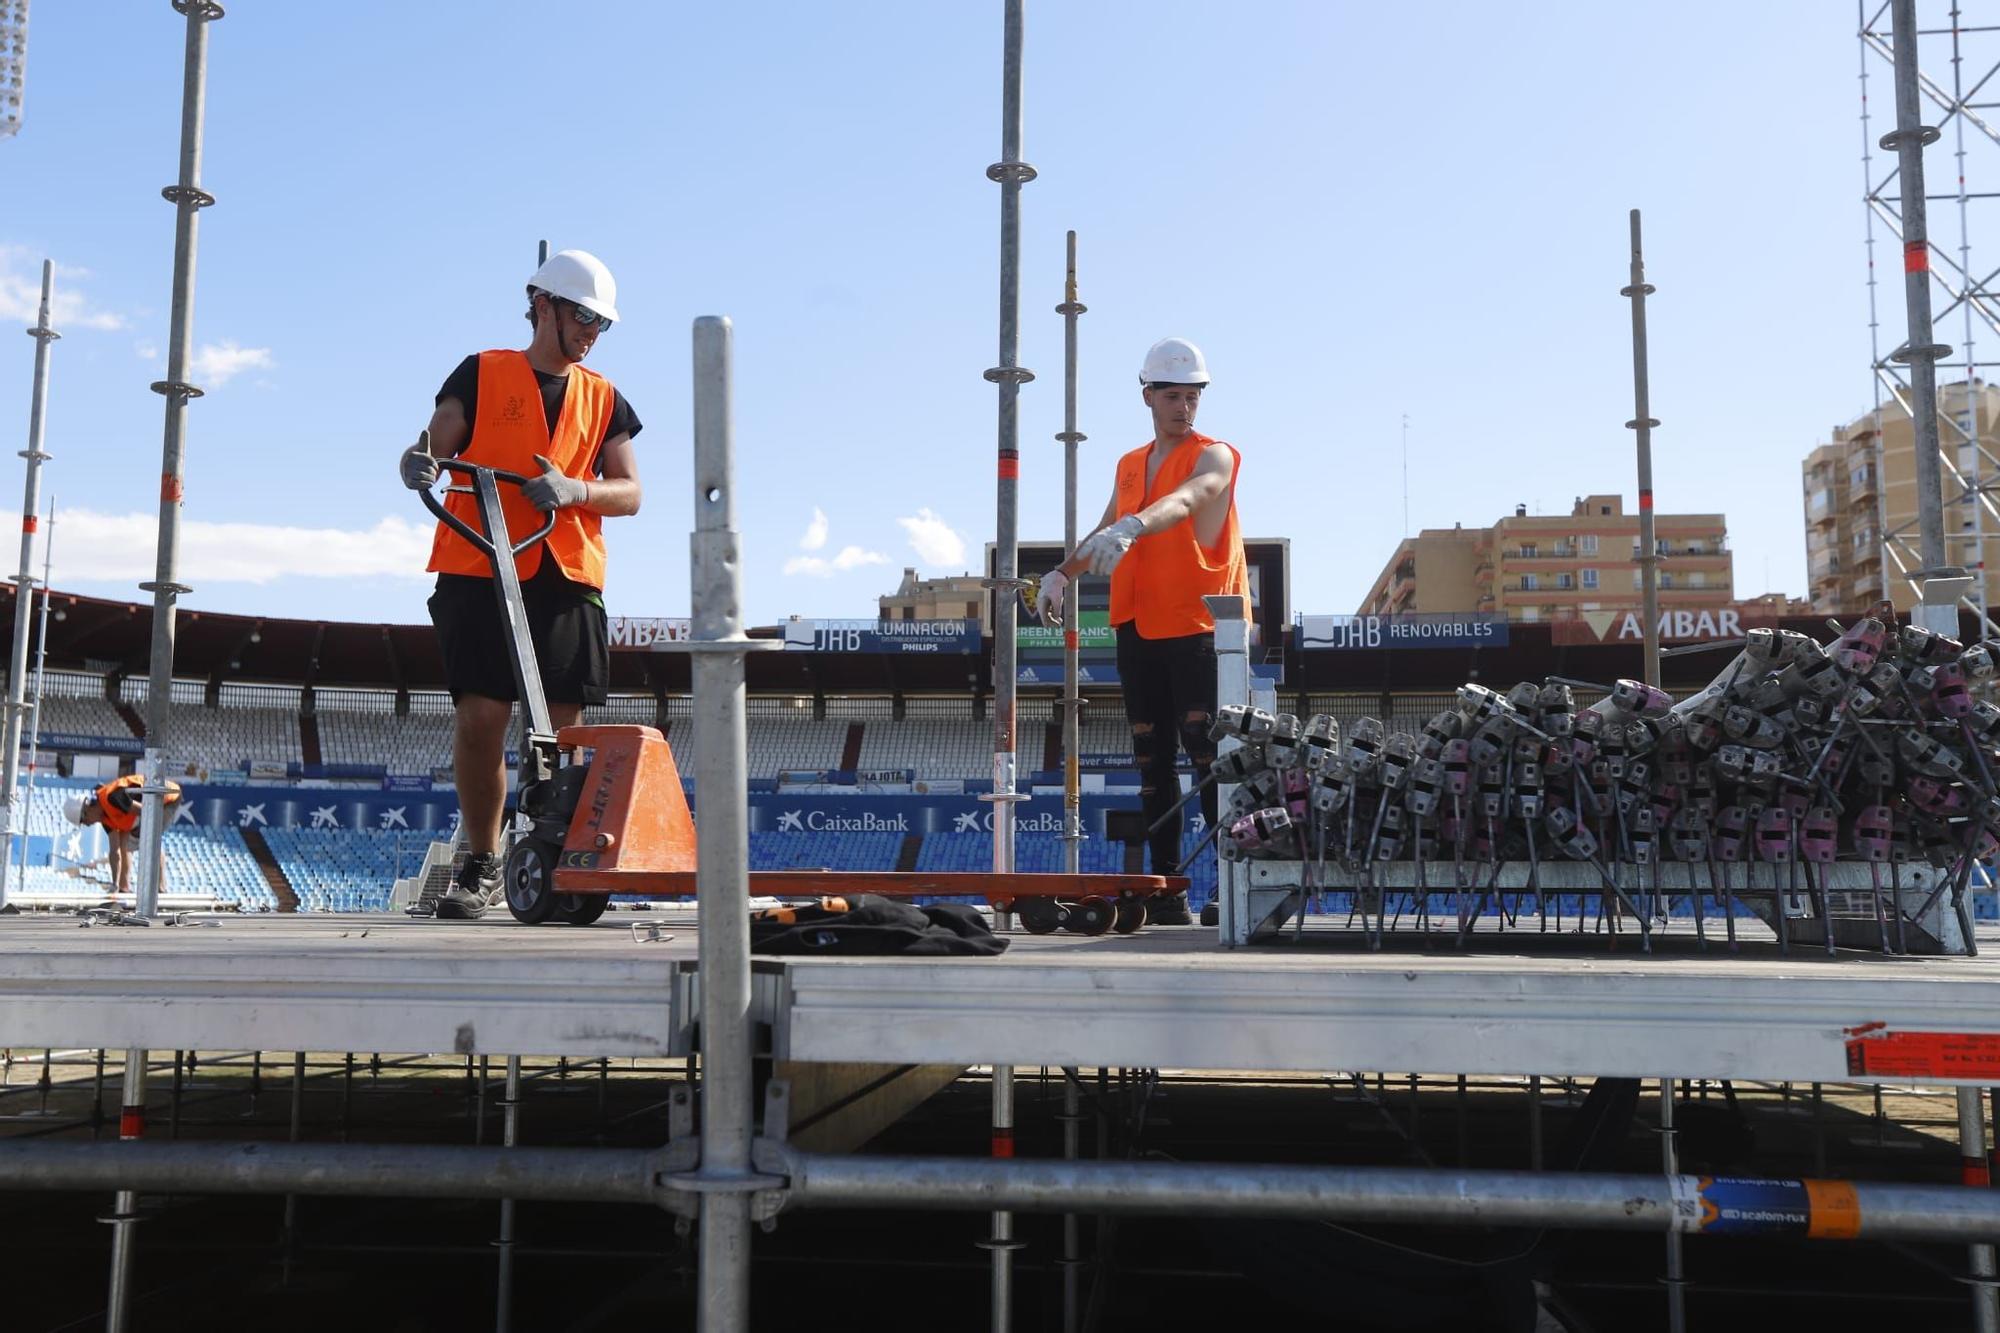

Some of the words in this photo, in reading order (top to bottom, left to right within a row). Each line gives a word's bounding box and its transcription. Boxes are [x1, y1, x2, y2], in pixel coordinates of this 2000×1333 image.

[607, 619, 692, 646] MBAR
[871, 619, 966, 636] ILUMINACIÓN
[1056, 627, 1109, 637] BANIC
[1338, 616, 1381, 647] JAB
[1390, 622, 1492, 638] RENOVABLES
[902, 643, 938, 651] PHILIPS
[807, 810, 909, 832] CaixaBank
[984, 812, 1086, 832] CixaBak
